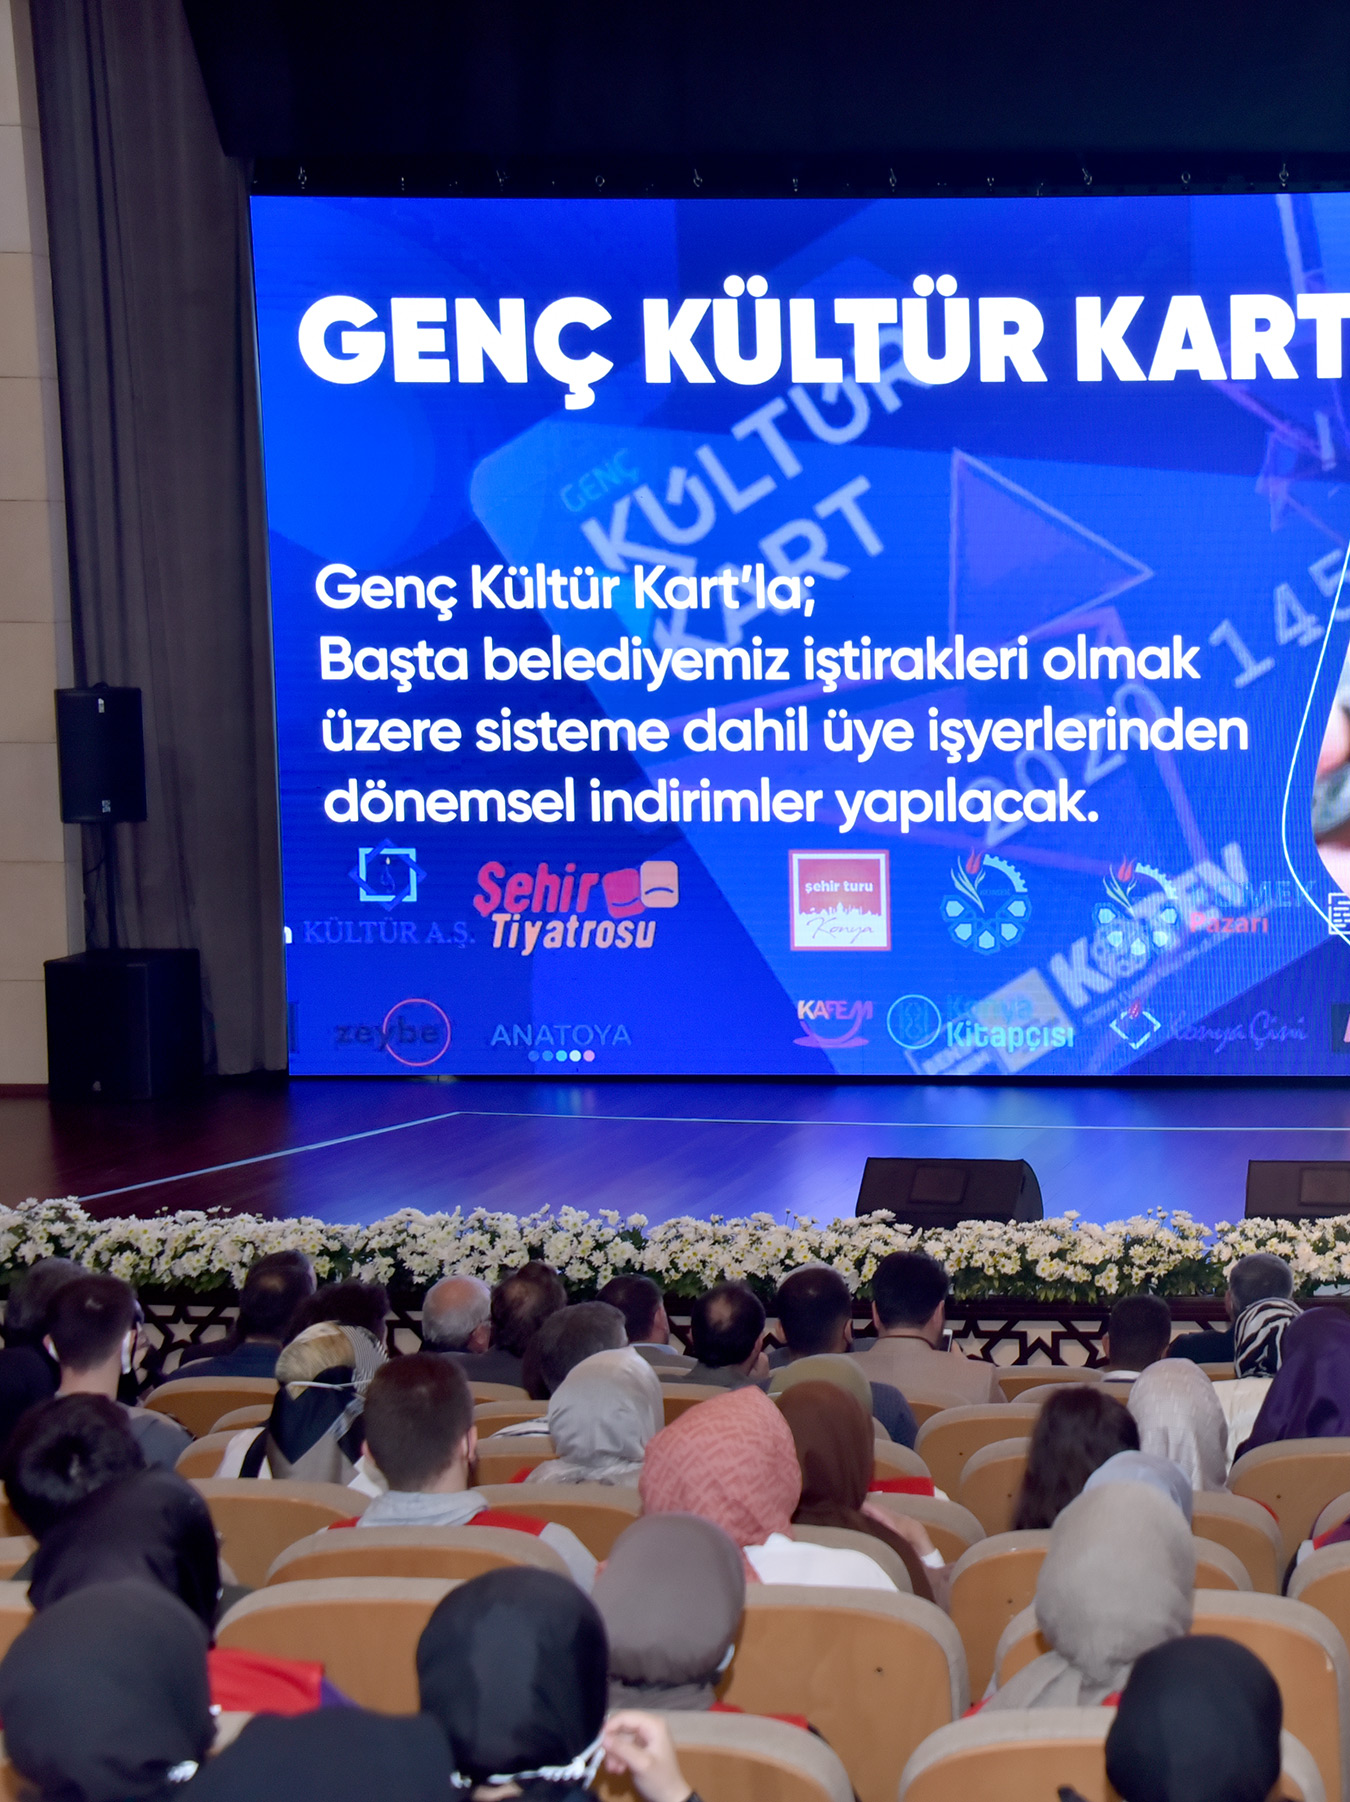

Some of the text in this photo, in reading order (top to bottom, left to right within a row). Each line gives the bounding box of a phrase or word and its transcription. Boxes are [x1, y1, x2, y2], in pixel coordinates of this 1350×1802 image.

[298, 295, 614, 410] GENÇ
[643, 274, 1048, 385] KÜLTÜR
[315, 563, 815, 622] Genç Kültür Kart'la;
[320, 633, 1201, 693] Başta belediyemiz iştirakleri olmak
[322, 705, 1249, 764] üzere sisteme dahil üye işyerlerinden
[324, 776, 1099, 834] dönemsel indirimler yapılacak.
[473, 861, 599, 917] Şehir
[804, 879, 874, 895] şehir turu
[302, 916, 476, 949] KÜLTÜR A.Ş.
[491, 913, 657, 956] Tiyatrosu
[806, 916, 875, 944] Konya
[1190, 911, 1268, 933] Pazarı
[797, 999, 873, 1020] KAFEM
[490, 1023, 633, 1047] ANATOYA
[946, 1020, 1074, 1053] Kitapçısı
